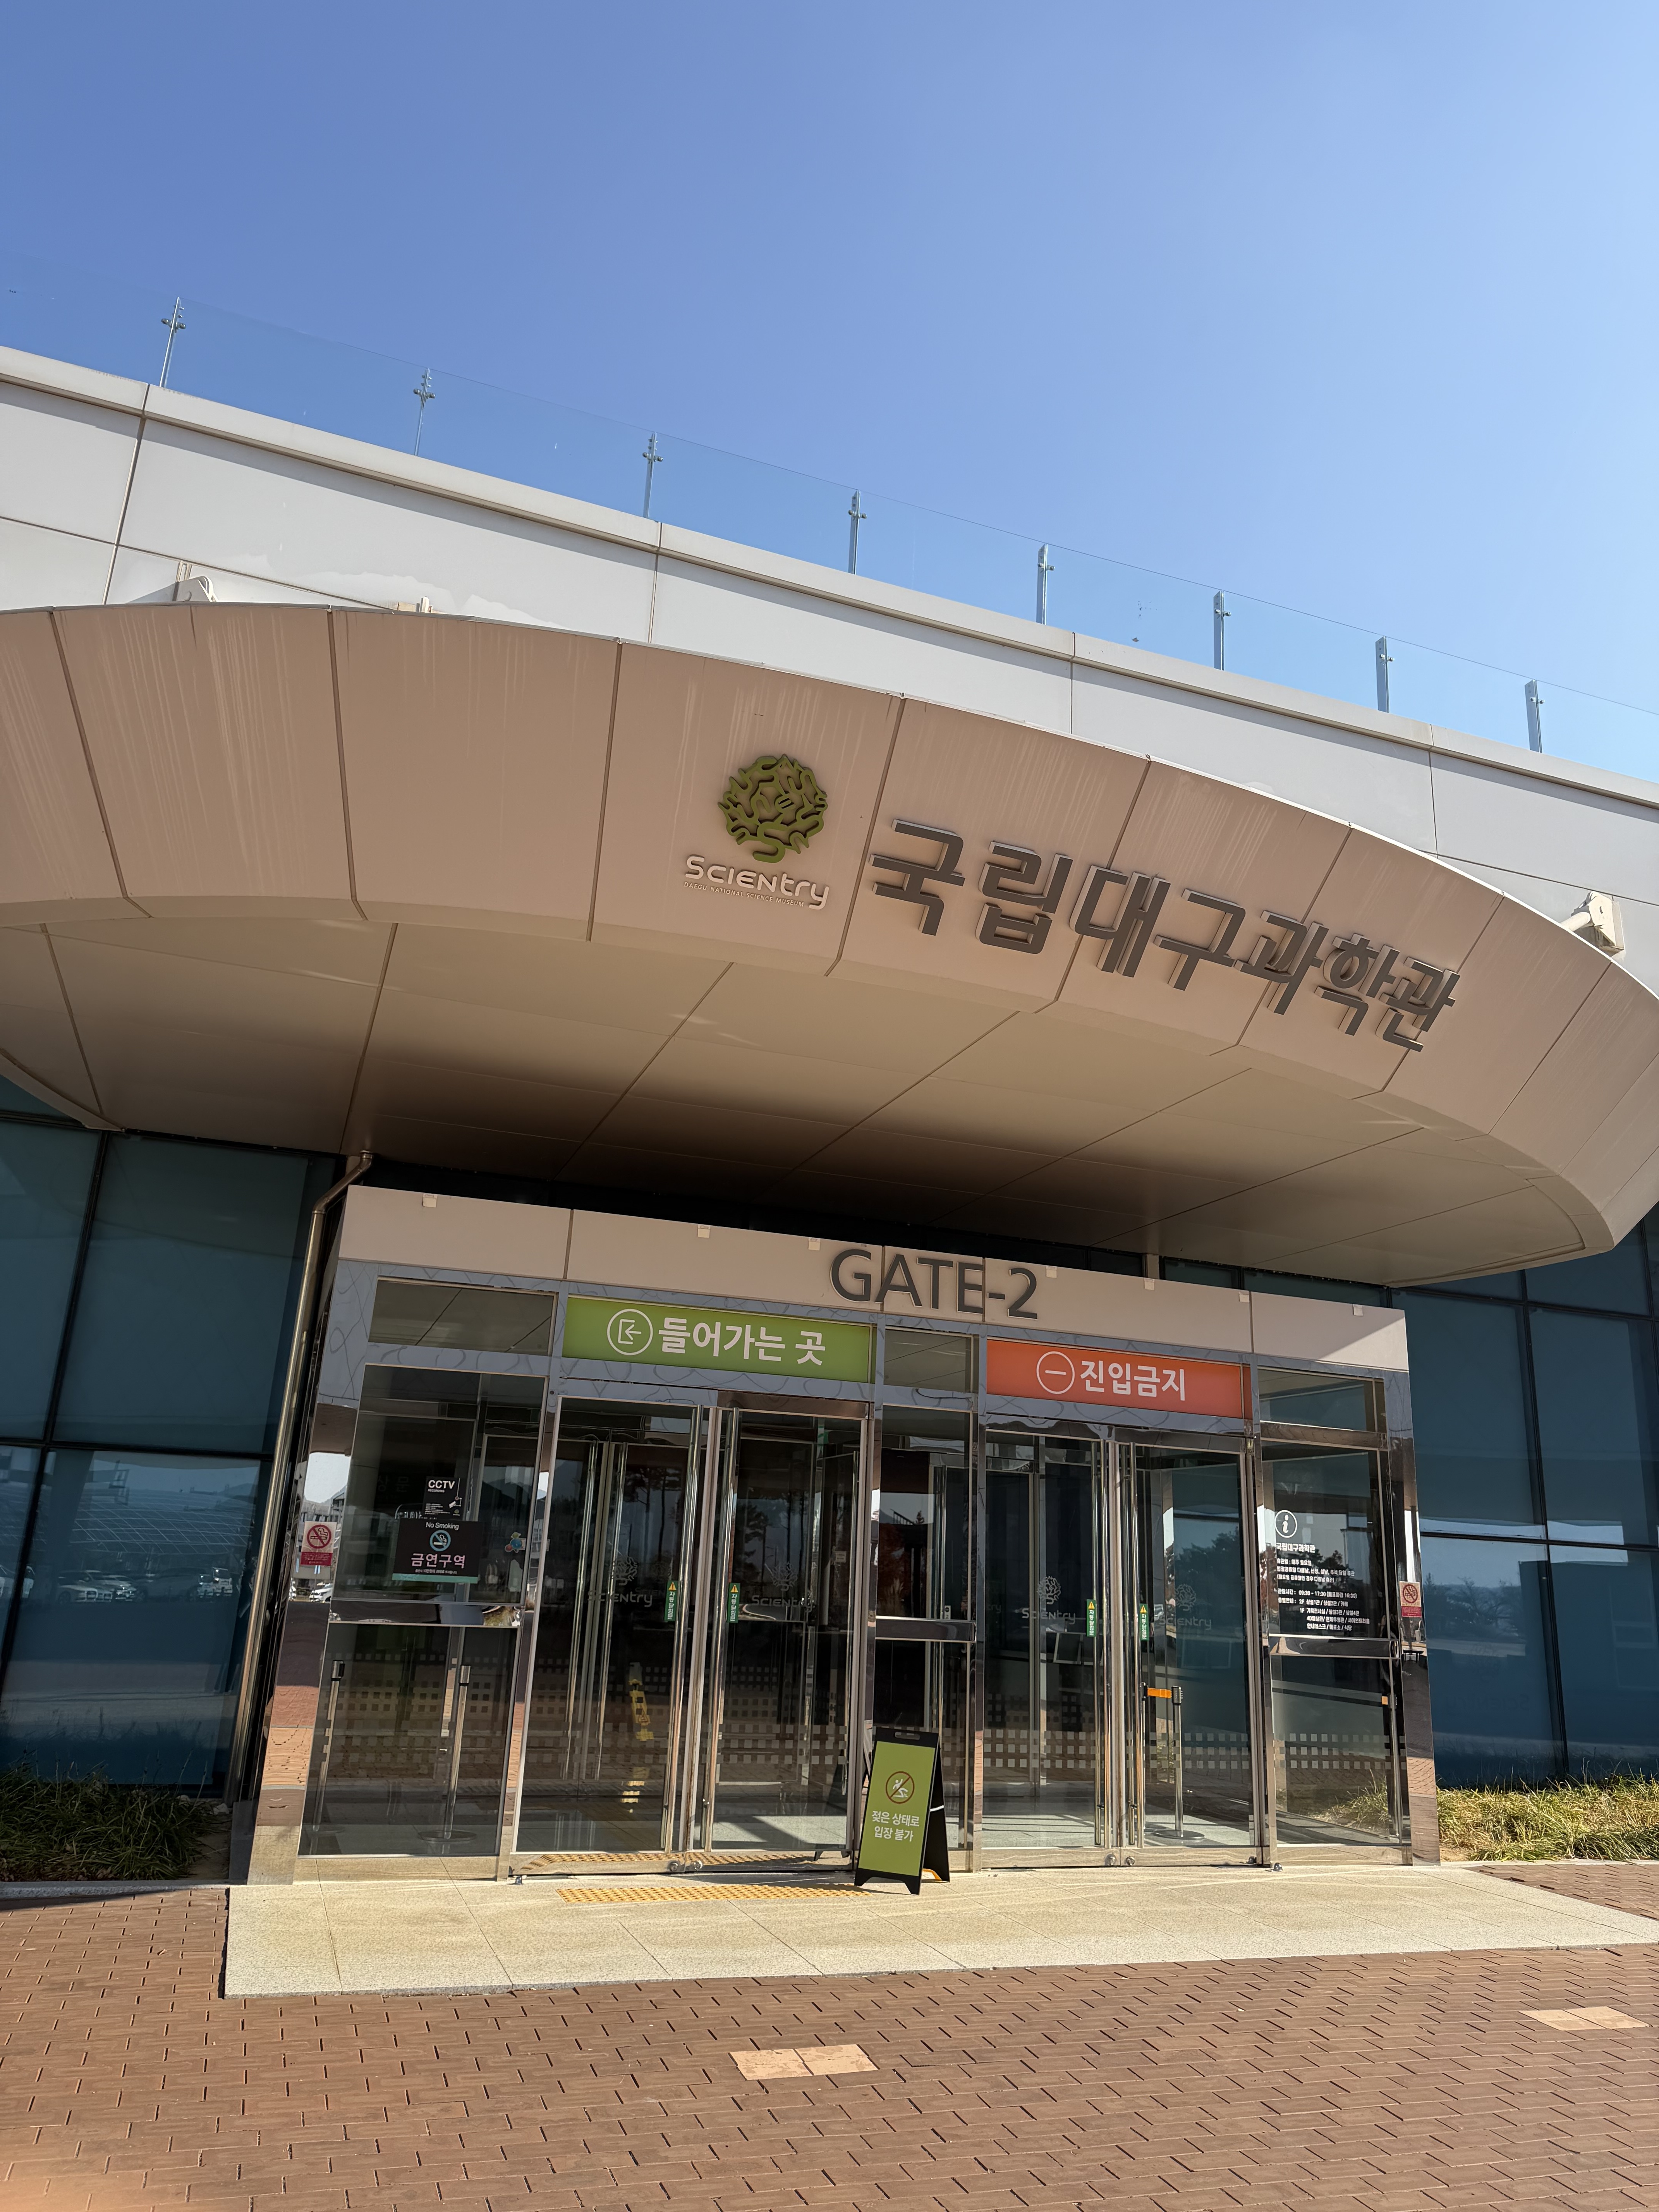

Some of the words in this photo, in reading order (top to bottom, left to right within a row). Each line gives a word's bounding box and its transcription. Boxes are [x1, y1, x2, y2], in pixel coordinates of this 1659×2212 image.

[684, 881, 707, 890] DAEGU
[710, 886, 744, 897] NATIONAL
[746, 893, 773, 902] SCIENCE
[776, 898, 804, 907] MUSEUM
[869, 818, 1460, 1053] 국립대구과학관
[830, 1249, 1038, 1320] GATE-2
[658, 1318, 787, 1362] 들어가는
[795, 1331, 825, 1366] 곳
[1080, 1360, 1185, 1401] 진입금지
[428, 1480, 455, 1489] CCTV
[435, 1522, 459, 1530] Smoking
[1276, 1542, 1316, 1553] 국립대구과학관
[411, 1553, 465, 1569] 금연구역
[872, 1810, 890, 1824] 젖은
[892, 1813, 920, 1827] 상태로
[874, 1826, 893, 1839] 입장
[895, 1829, 914, 1842] 불가
